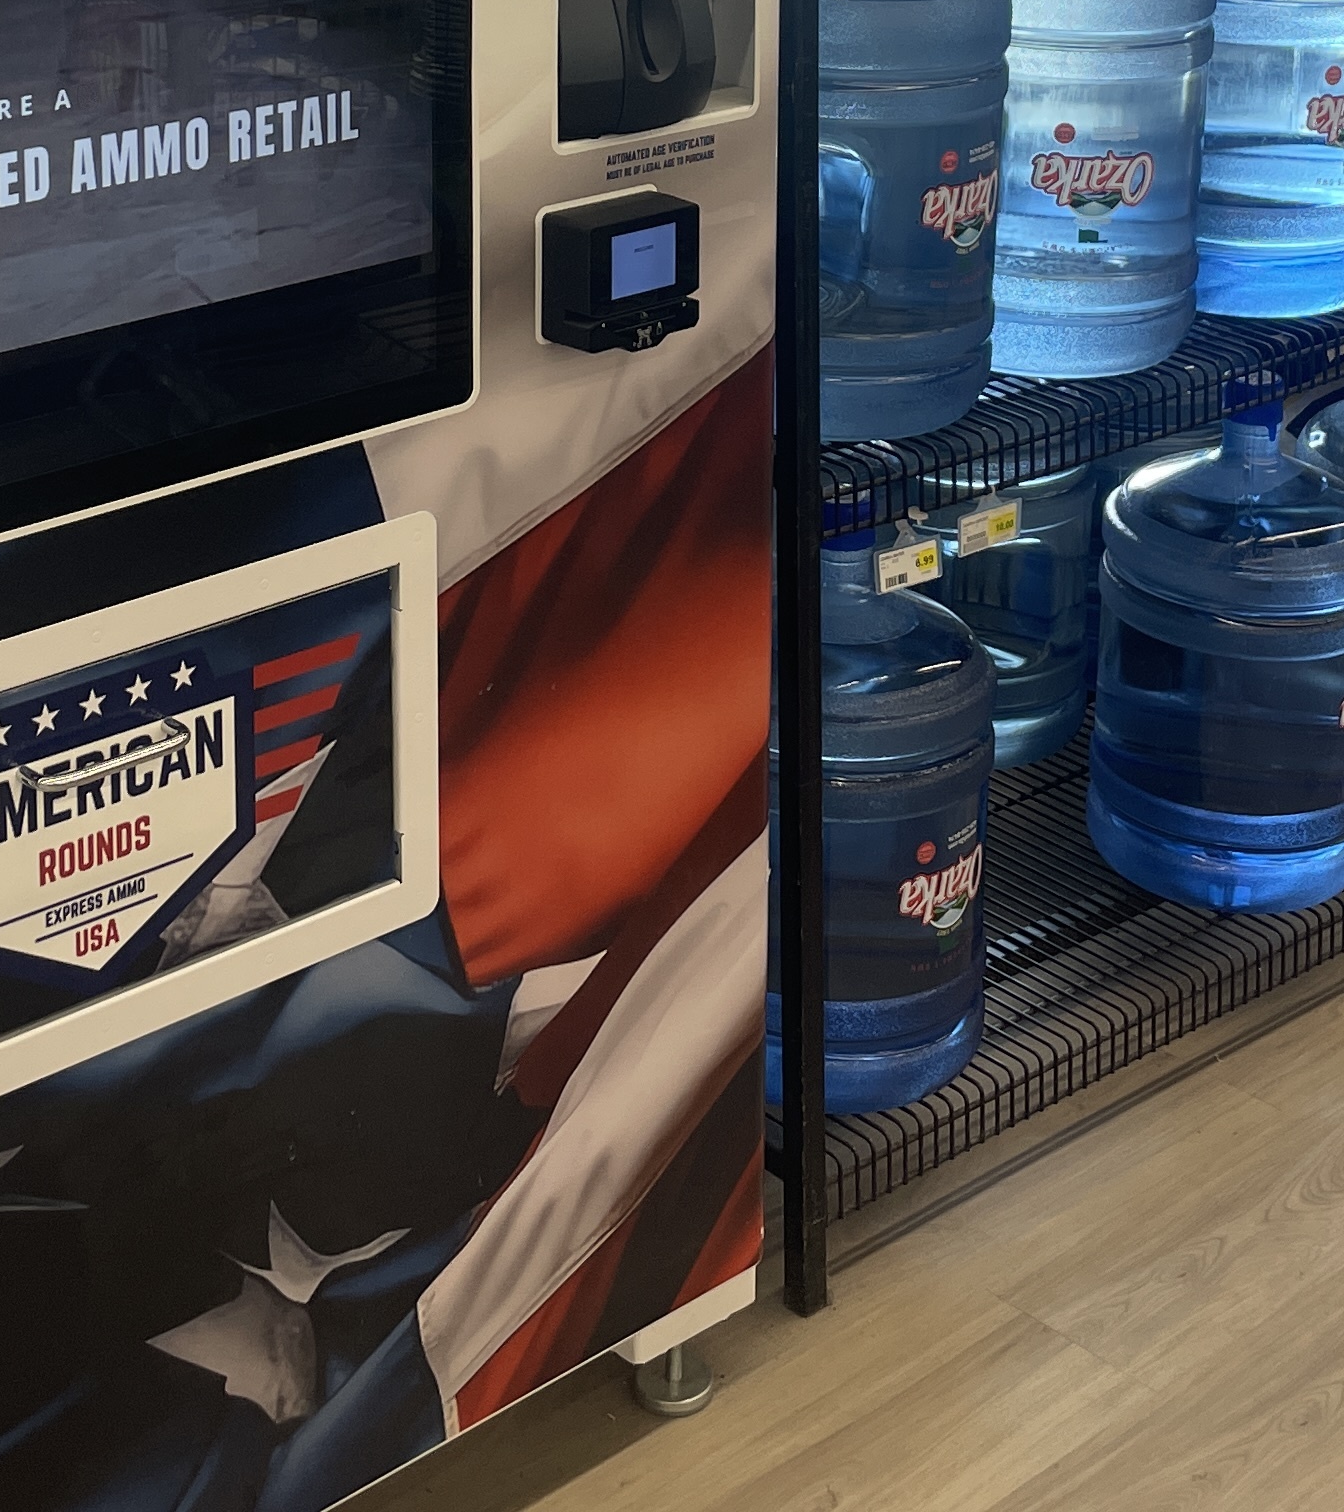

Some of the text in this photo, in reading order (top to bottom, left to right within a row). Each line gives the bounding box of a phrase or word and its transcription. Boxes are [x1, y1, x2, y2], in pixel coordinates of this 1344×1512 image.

[54, 89, 73, 112] A
[69, 115, 211, 195] AMMO
[227, 89, 360, 164] RETAIL
[606, 133, 716, 167] AUTOMATED AGE VERIFICATION
[684, 149, 715, 165] PURCHASE
[1030, 151, 1156, 211] Ozarka
[915, 554, 935, 568] 6.99
[38, 814, 152, 888] ROUNDS
[44, 876, 147, 929] EXPRESS AMMO
[897, 840, 983, 926] Ozarka
[74, 918, 121, 958] USA
